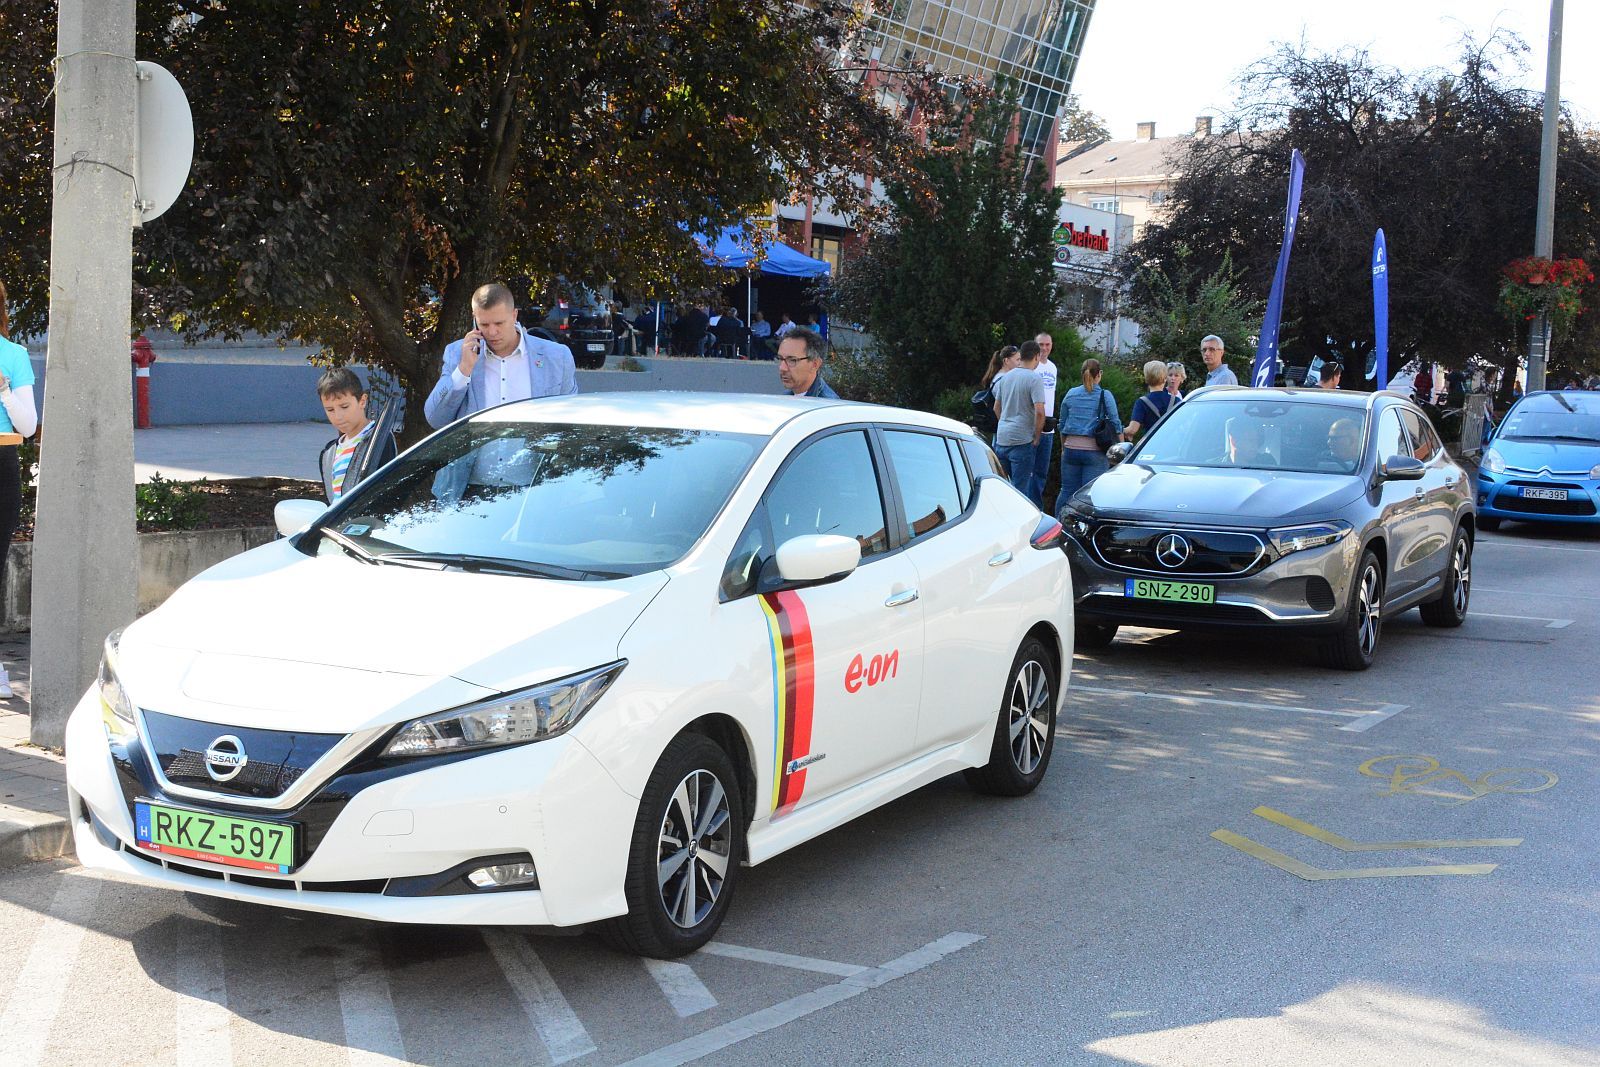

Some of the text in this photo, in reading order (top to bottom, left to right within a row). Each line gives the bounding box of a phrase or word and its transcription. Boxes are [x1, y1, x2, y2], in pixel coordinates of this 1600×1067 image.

[1525, 489, 1565, 499] RKF-395
[1137, 581, 1210, 601] SNZ-290
[140, 811, 284, 860] H RKZ-597
